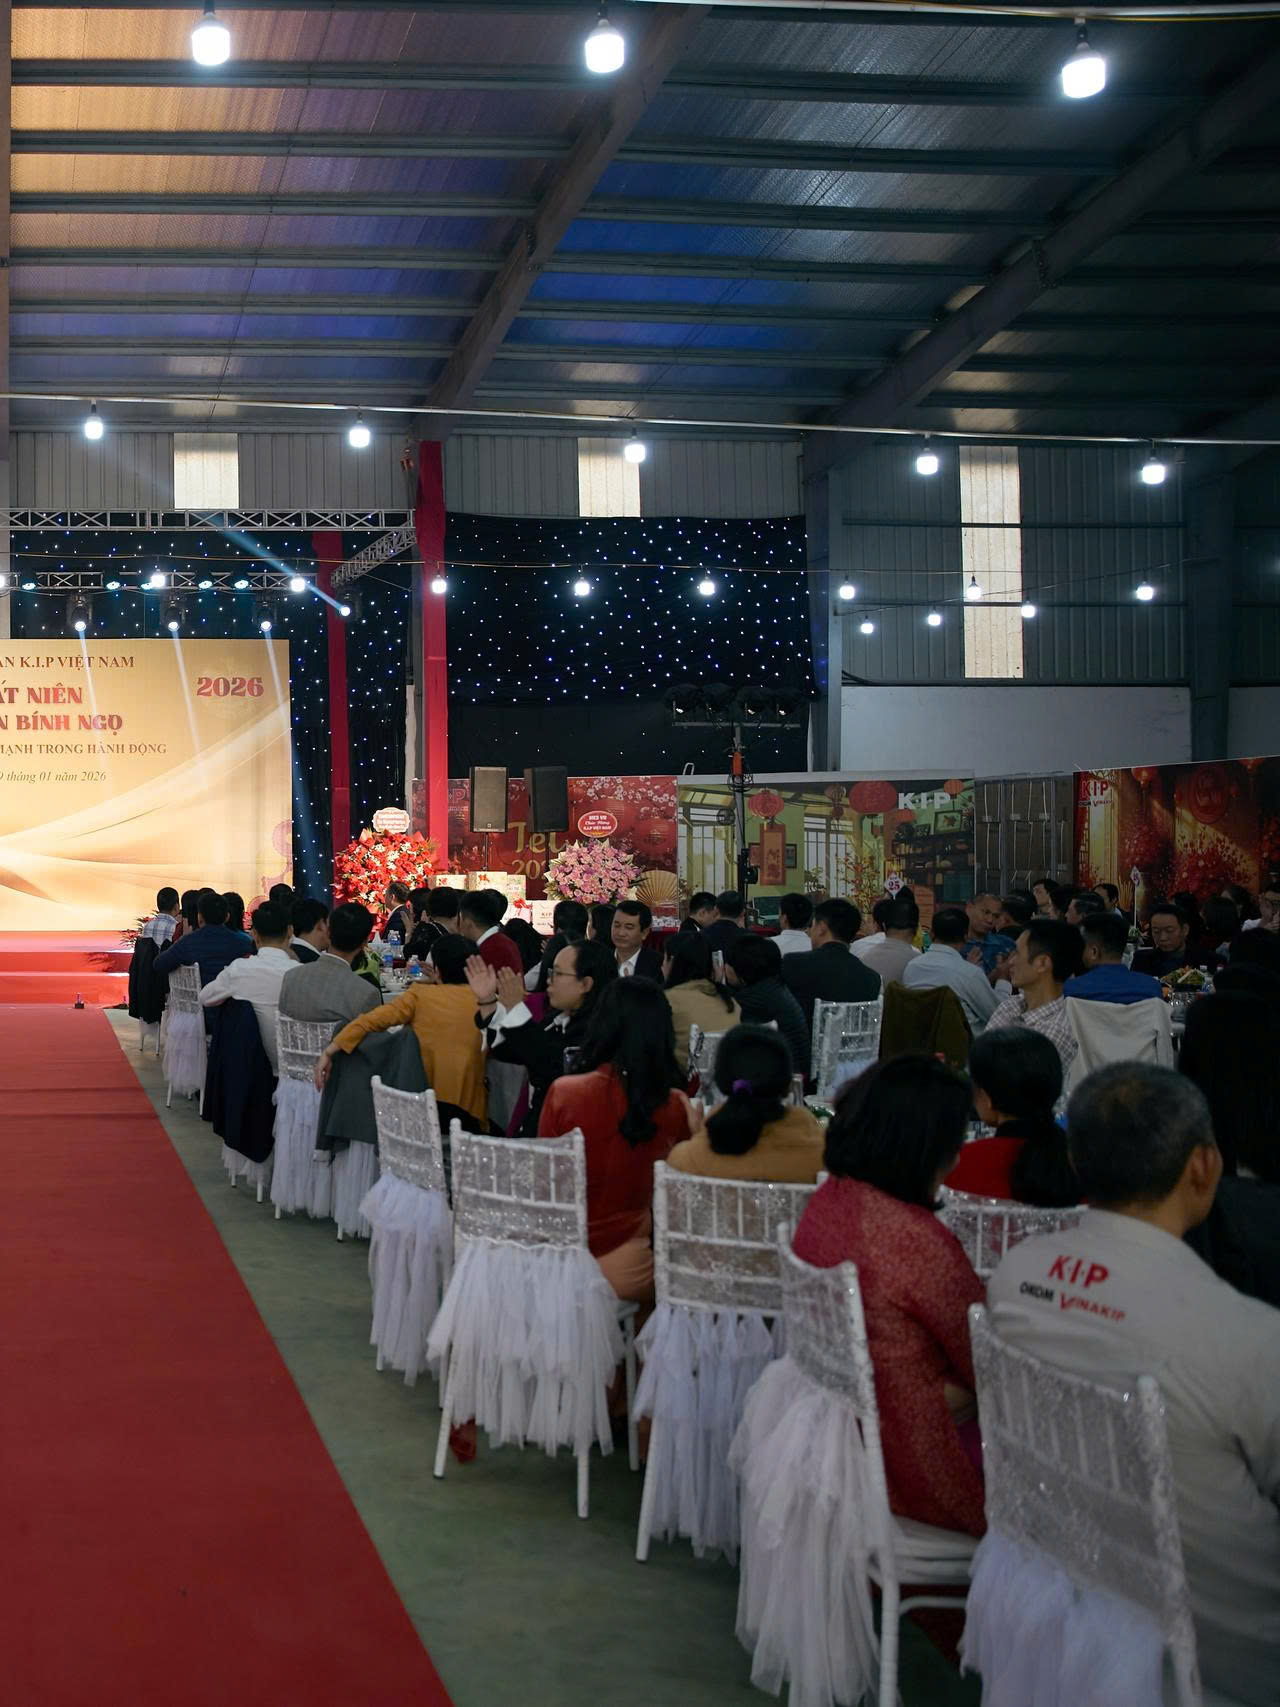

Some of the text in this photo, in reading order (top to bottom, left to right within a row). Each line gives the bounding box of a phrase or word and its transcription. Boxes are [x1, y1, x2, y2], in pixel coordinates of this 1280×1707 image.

[19, 656, 54, 668] K.I.P
[57, 655, 95, 671] VIỆT
[99, 656, 136, 668] NAM
[27, 682, 83, 704] NIÊN
[196, 676, 265, 697] 2026
[16, 710, 71, 731] BÍNH
[78, 714, 123, 736] NGỌ
[37, 743, 84, 755] TRONG
[87, 741, 125, 755] HÀNH
[129, 742, 168, 756] ĐỘNG
[6, 771, 36, 784] tháng
[39, 771, 51, 782] 01
[55, 772, 78, 782] năm
[81, 771, 107, 782] 2026
[888, 881, 900, 891] 25
